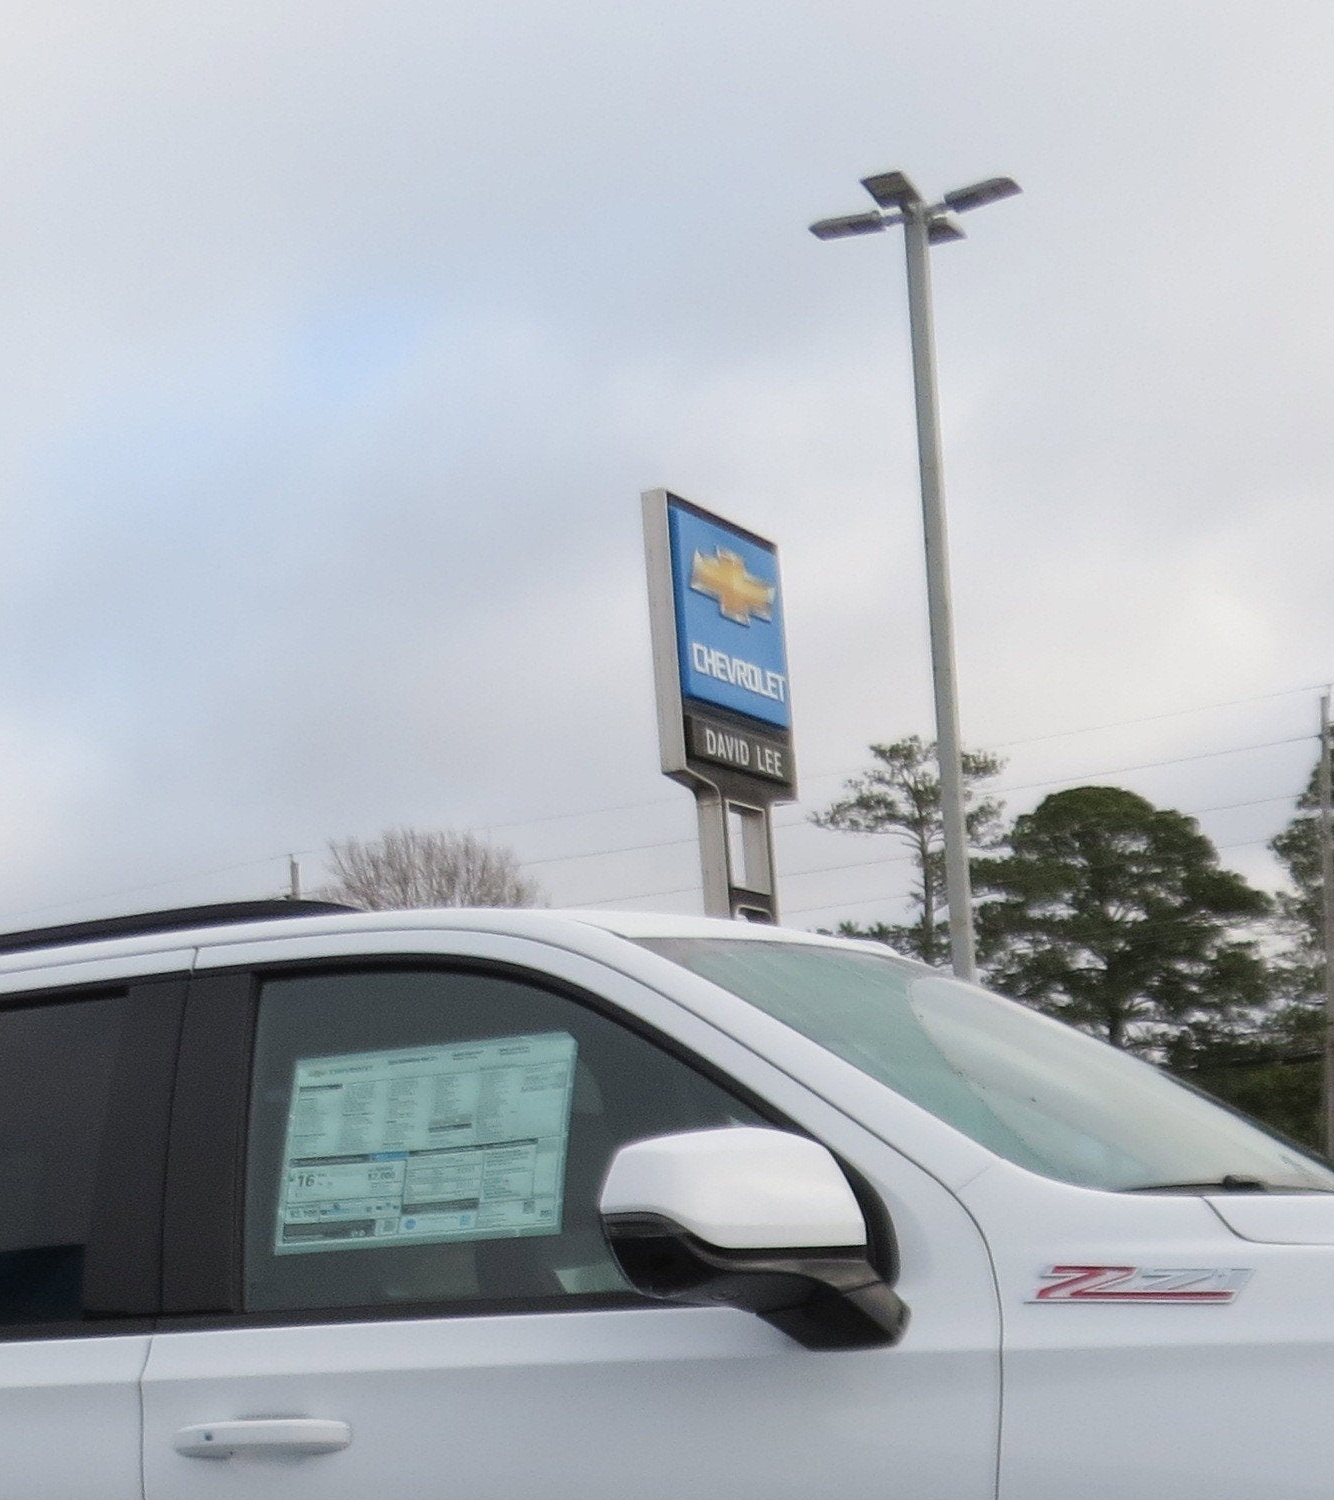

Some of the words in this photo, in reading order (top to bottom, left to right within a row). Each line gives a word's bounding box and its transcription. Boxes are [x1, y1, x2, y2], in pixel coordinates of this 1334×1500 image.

[692, 643, 786, 703] CHEVROLET
[705, 729, 750, 767] DAVID
[756, 745, 784, 778] LEE
